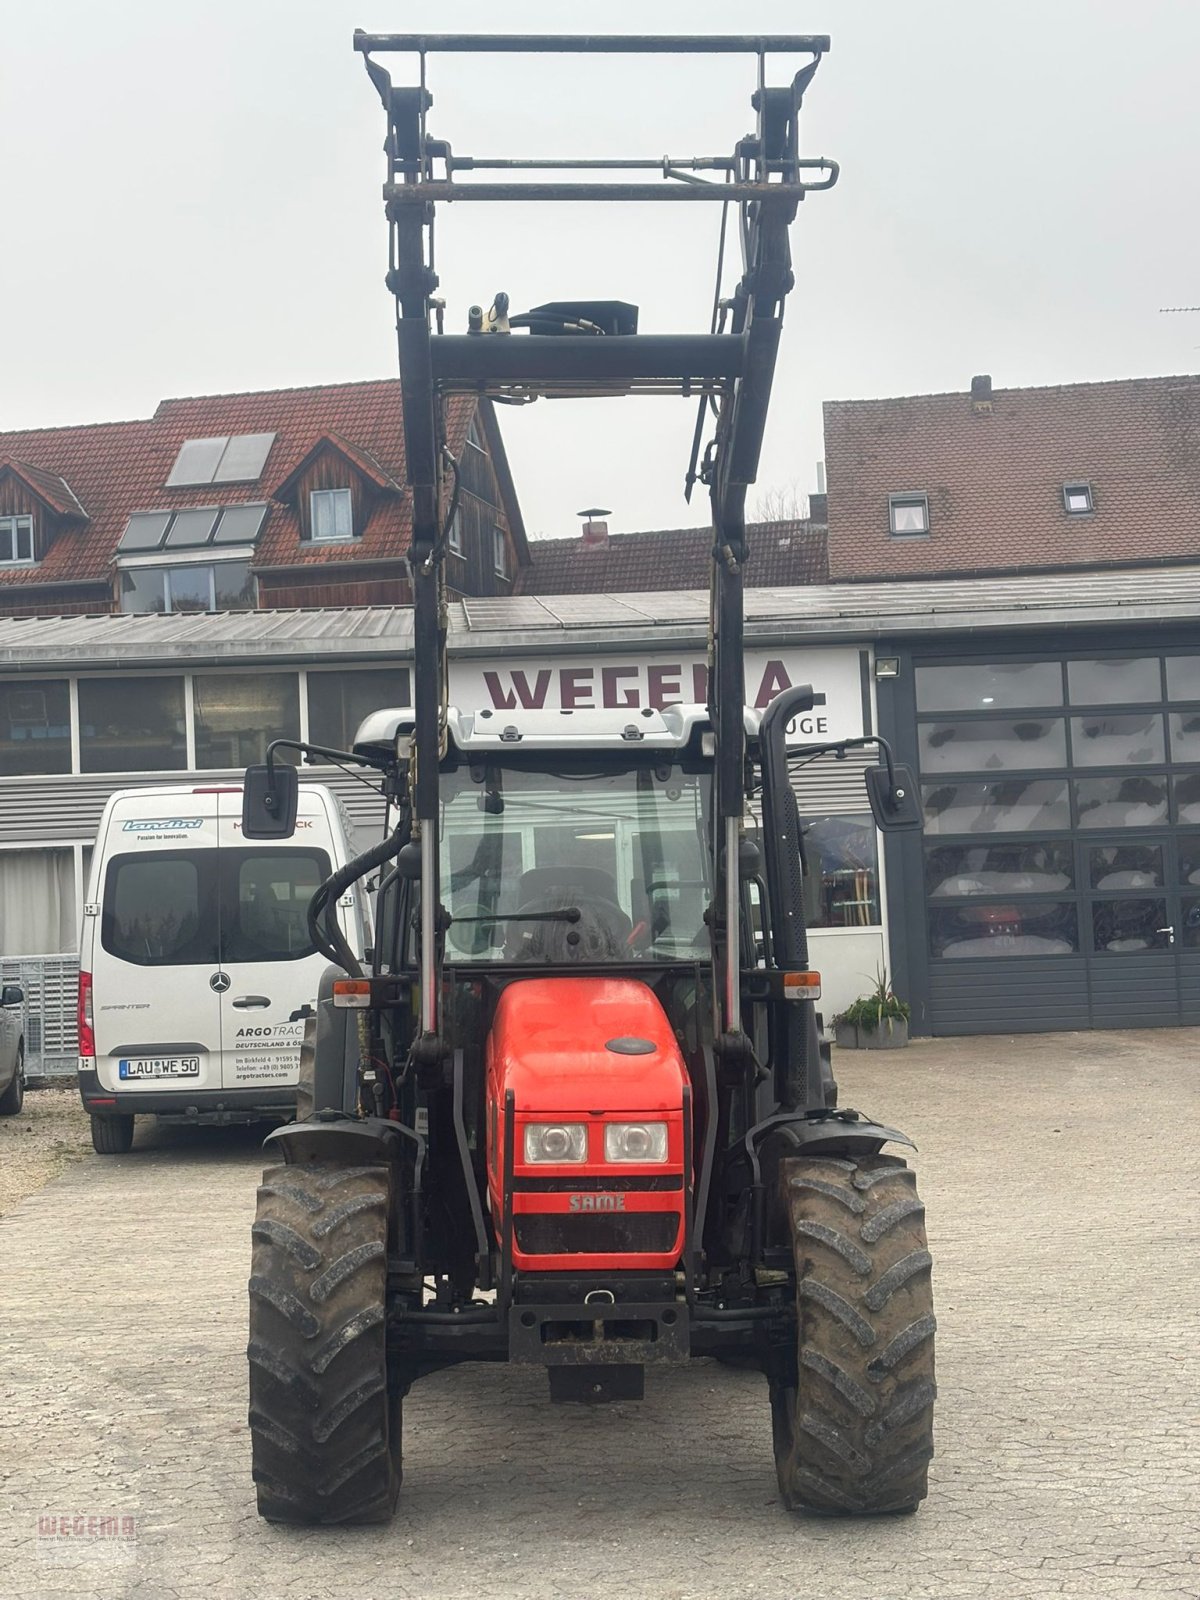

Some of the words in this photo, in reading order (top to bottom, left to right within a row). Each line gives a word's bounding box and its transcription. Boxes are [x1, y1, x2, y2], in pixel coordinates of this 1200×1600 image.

[483, 660, 792, 710] WEGEA
[122, 819, 204, 831] Landini
[100, 1003, 151, 1011] SPRINTER
[236, 1025, 305, 1037] ARGOTRAC
[235, 1041, 285, 1049] DEUTSCHLAND
[128, 1061, 153, 1075] LAU
[162, 1060, 179, 1073] WE
[181, 1059, 197, 1072] 50
[569, 1194, 626, 1212] SAME
